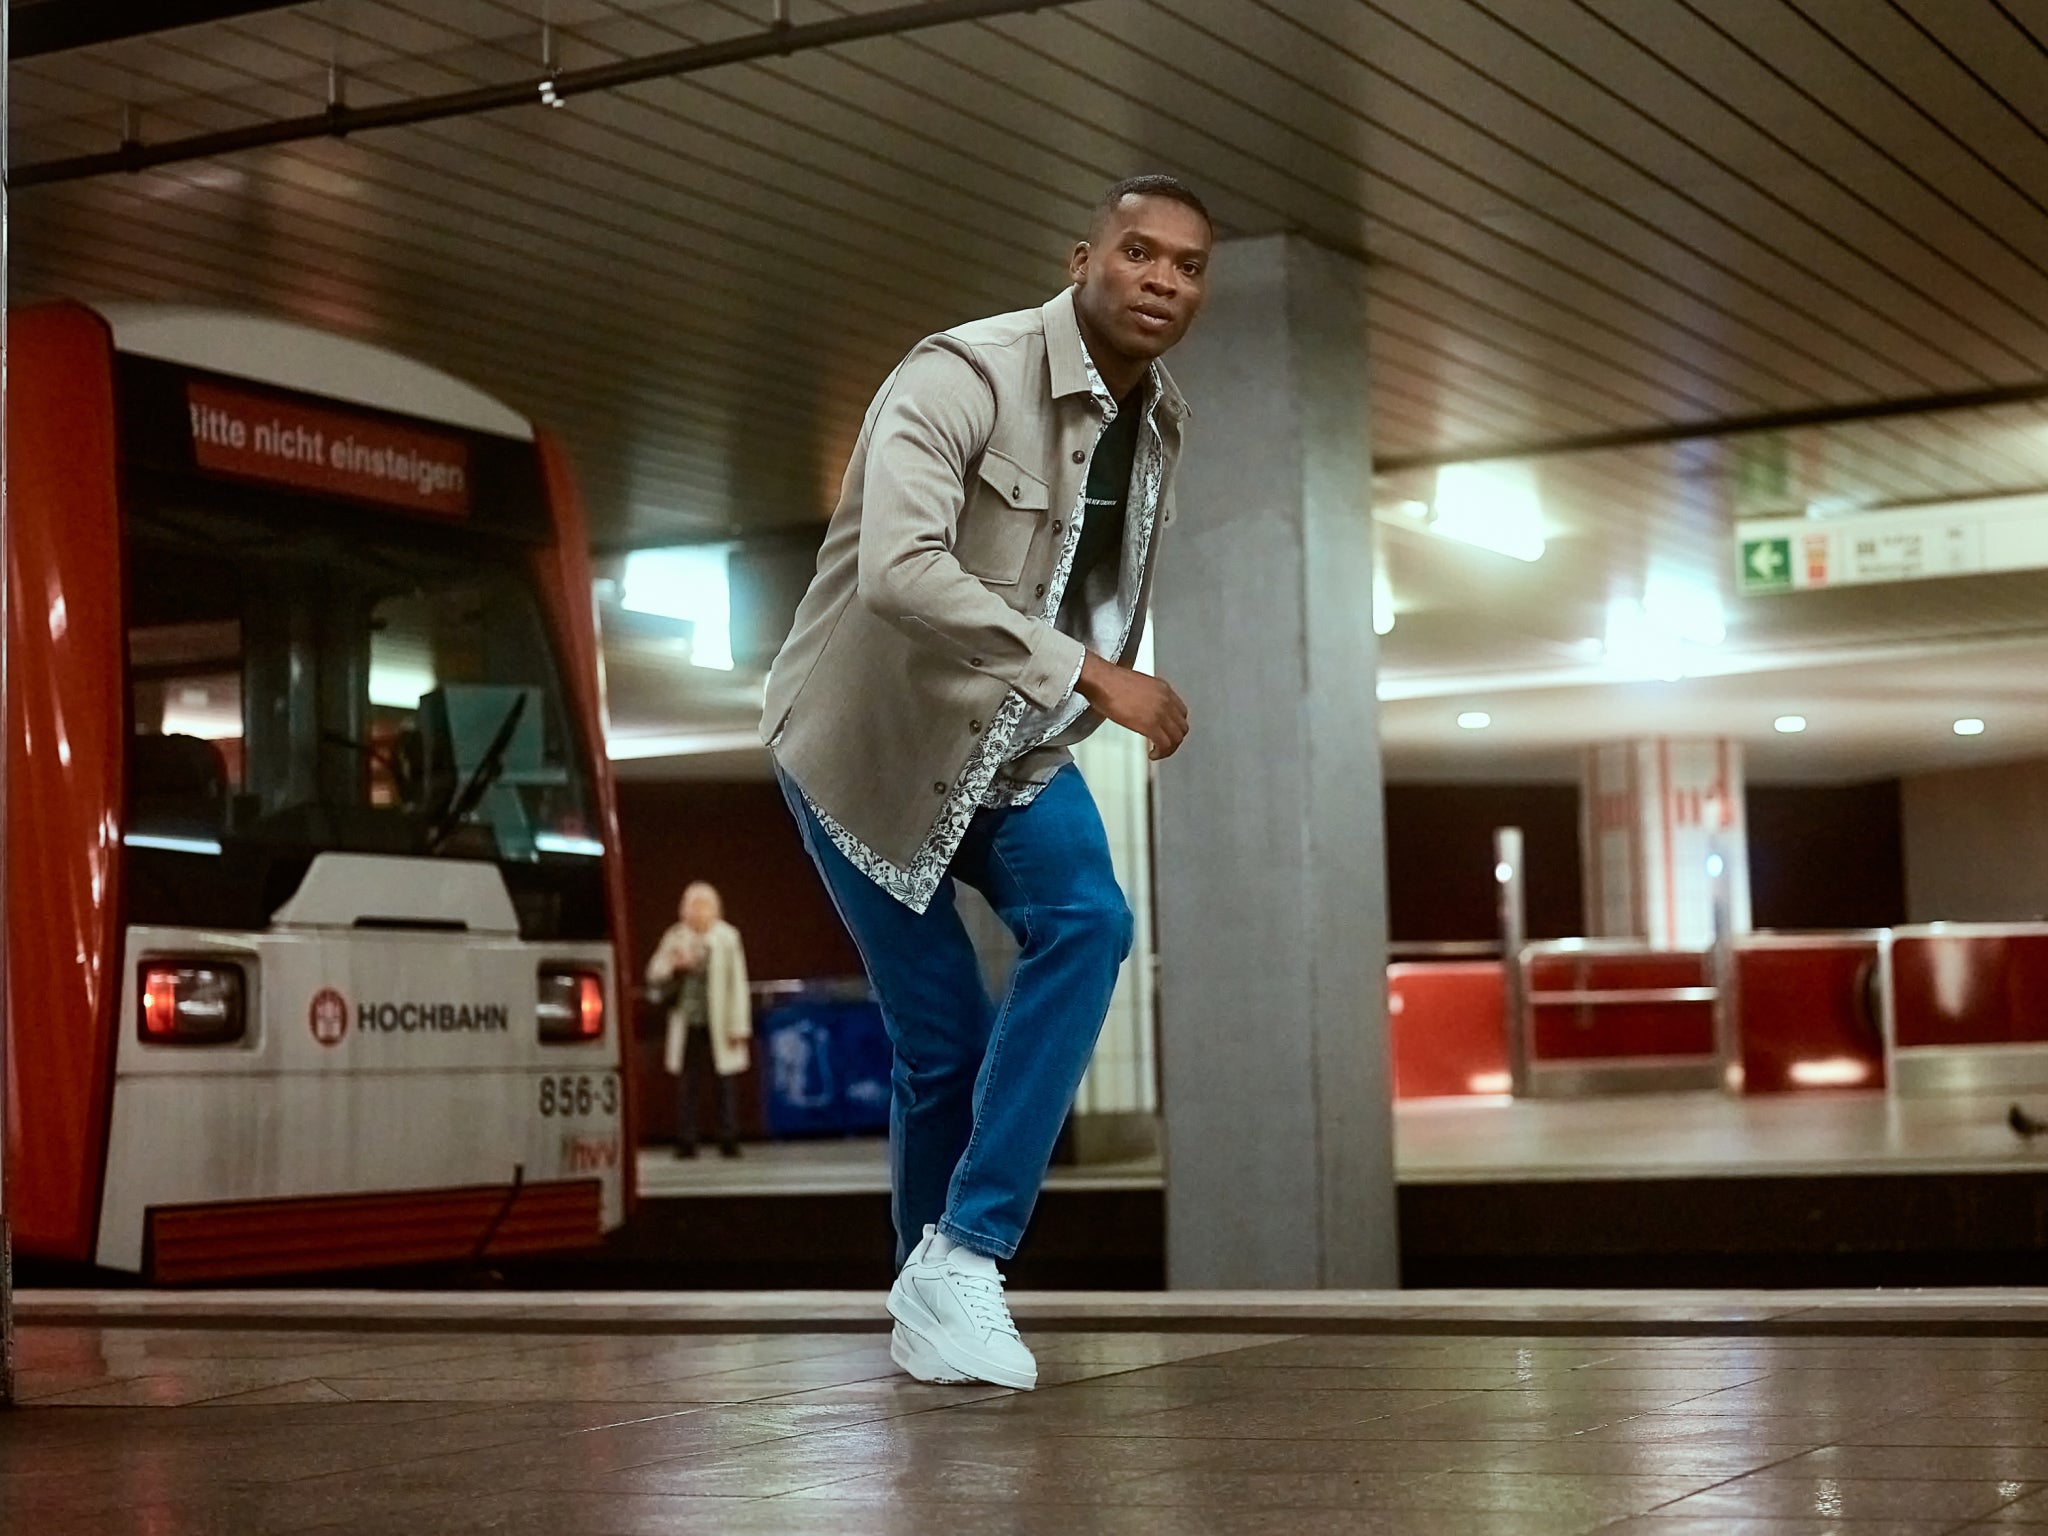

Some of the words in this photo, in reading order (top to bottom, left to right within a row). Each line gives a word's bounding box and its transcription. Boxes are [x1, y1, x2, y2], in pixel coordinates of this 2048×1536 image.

[254, 418, 324, 464] nicht
[330, 436, 464, 494] einsteigen
[357, 1004, 507, 1032] HOCHBAHN
[539, 1075, 617, 1117] 856-3
